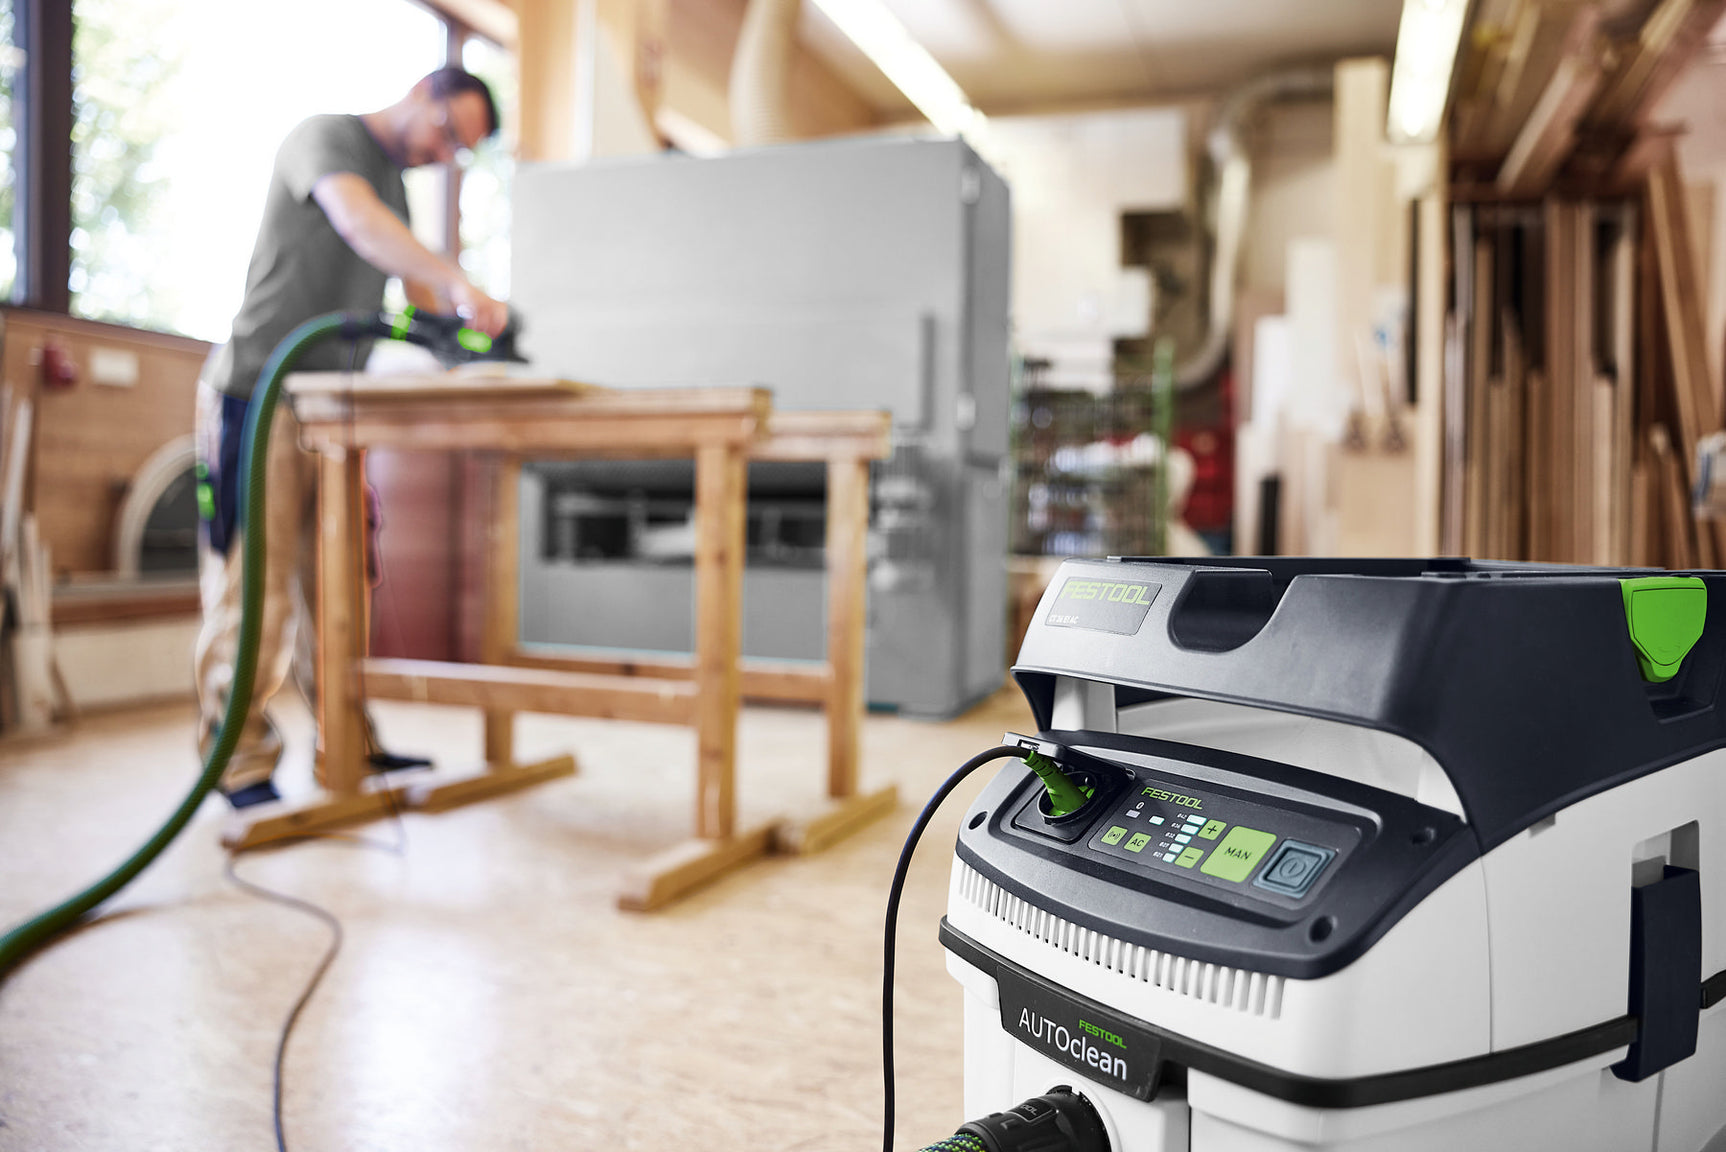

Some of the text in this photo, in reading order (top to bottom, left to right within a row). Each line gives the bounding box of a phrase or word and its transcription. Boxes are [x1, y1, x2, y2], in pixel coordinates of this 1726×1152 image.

[1060, 580, 1151, 605] FESTOOL
[1141, 786, 1203, 810] FESTOOL
[1129, 838, 1145, 847] AC
[1223, 846, 1252, 861] MAN
[1018, 1007, 1128, 1081] AUTOclean
[1078, 1019, 1127, 1049] FESTOOL
